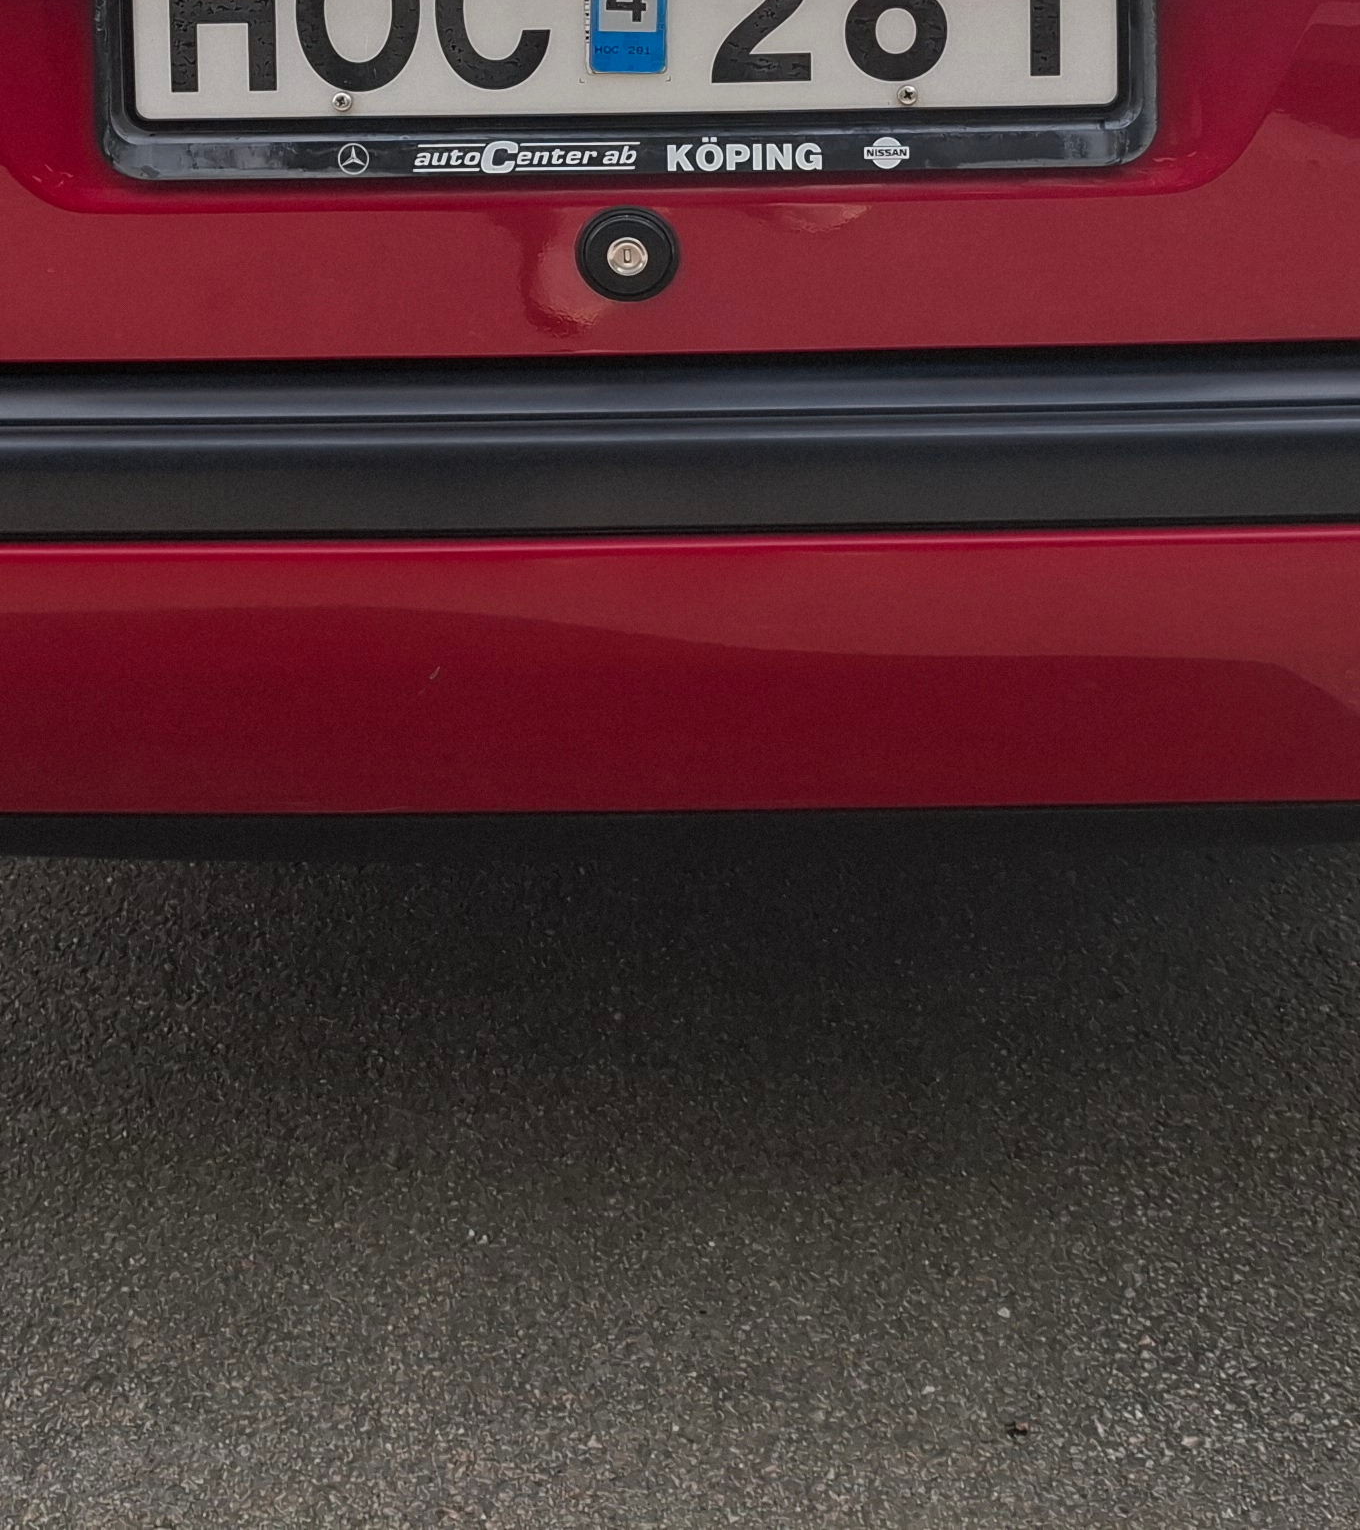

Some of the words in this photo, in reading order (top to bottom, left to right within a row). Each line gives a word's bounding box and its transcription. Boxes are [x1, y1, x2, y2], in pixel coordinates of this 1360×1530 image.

[594, 45, 619, 55] HOC
[414, 140, 597, 174] autoCenter
[602, 145, 638, 164] ab
[666, 136, 823, 172] KÖPING
[866, 148, 907, 157] NISSAN
